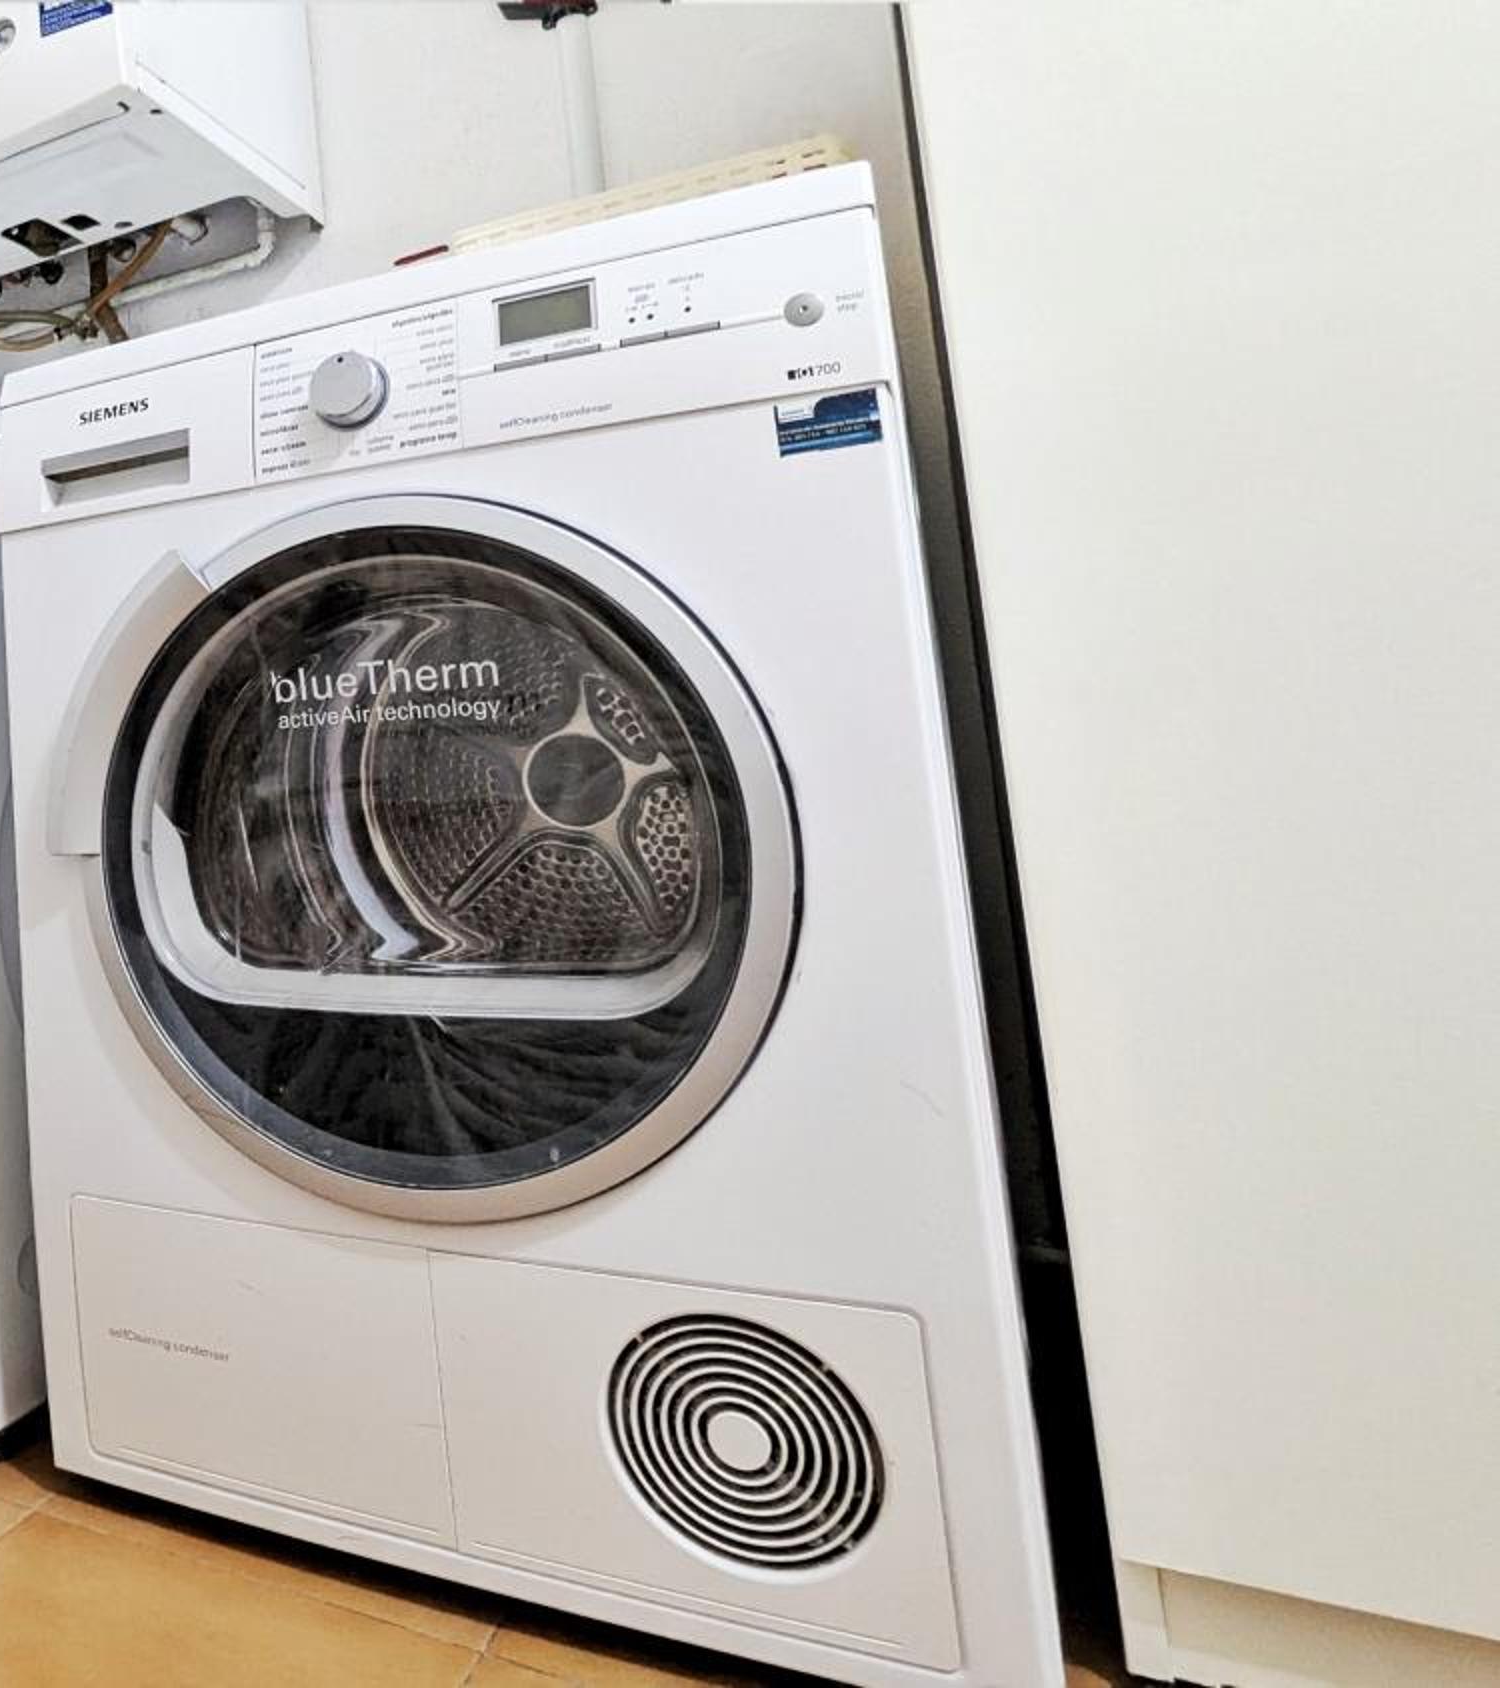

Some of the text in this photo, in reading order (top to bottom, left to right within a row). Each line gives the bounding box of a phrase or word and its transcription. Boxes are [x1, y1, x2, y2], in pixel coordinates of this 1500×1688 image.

[78, 397, 149, 425] SIEMENS
[270, 658, 500, 703] blueTherm
[278, 698, 500, 729] activeAir technology
